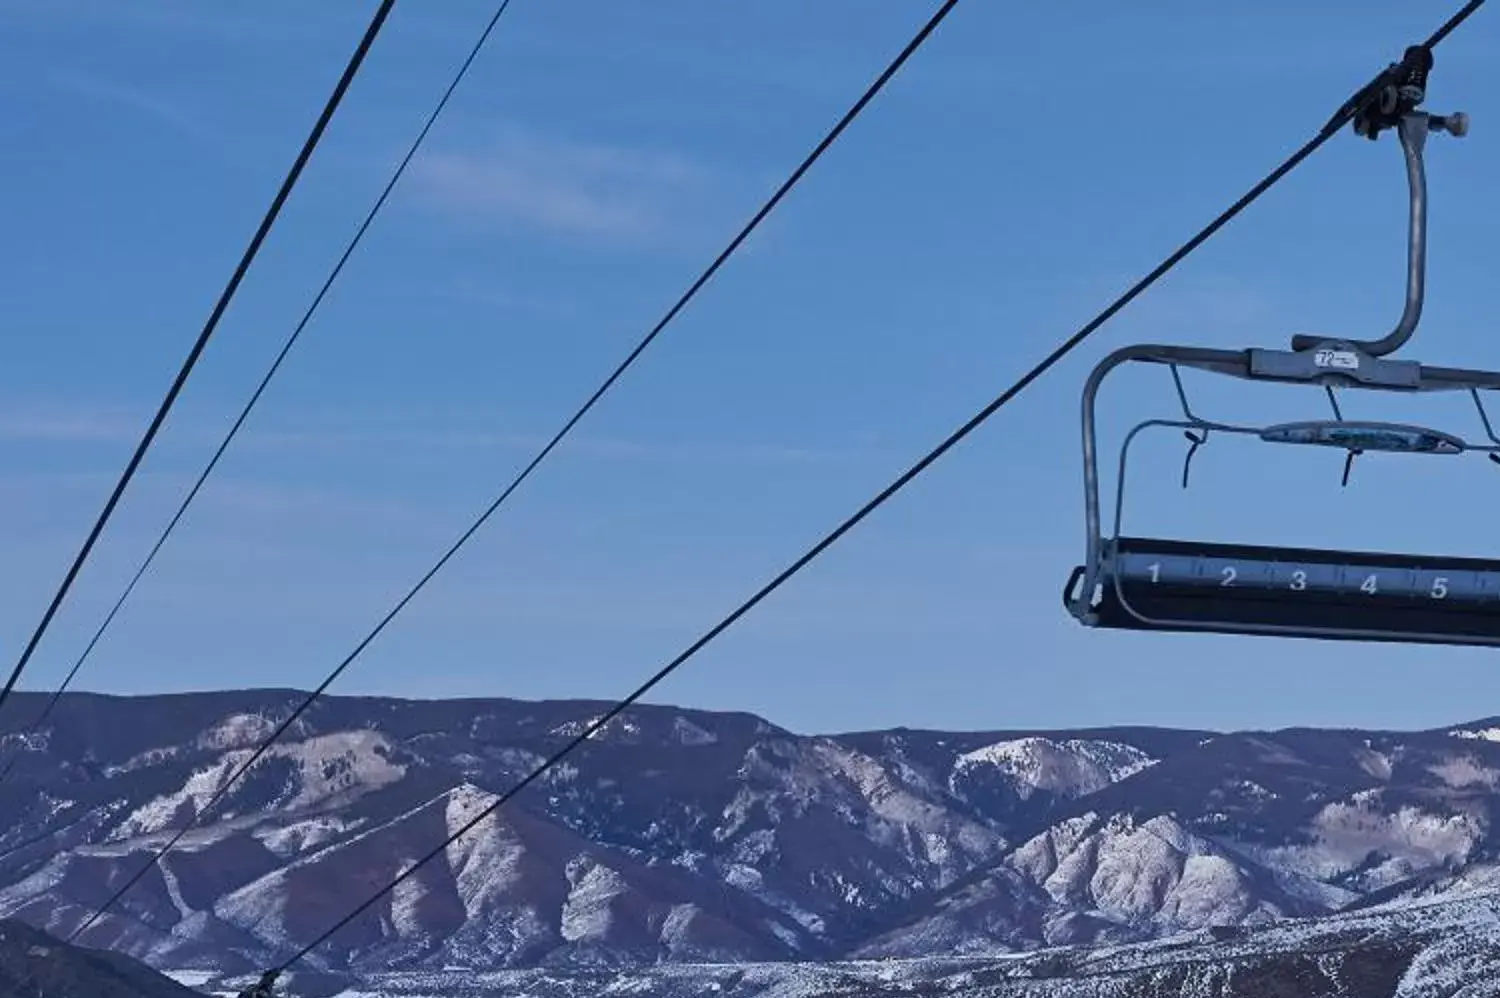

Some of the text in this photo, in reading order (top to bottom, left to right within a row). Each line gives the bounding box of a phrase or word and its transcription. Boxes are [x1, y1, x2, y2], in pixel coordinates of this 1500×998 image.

[1147, 562, 1160, 583] 1
[1220, 566, 1237, 586] 2
[1289, 570, 1307, 591] 3
[1359, 574, 1377, 595] 4
[1430, 577, 1448, 600] 5
